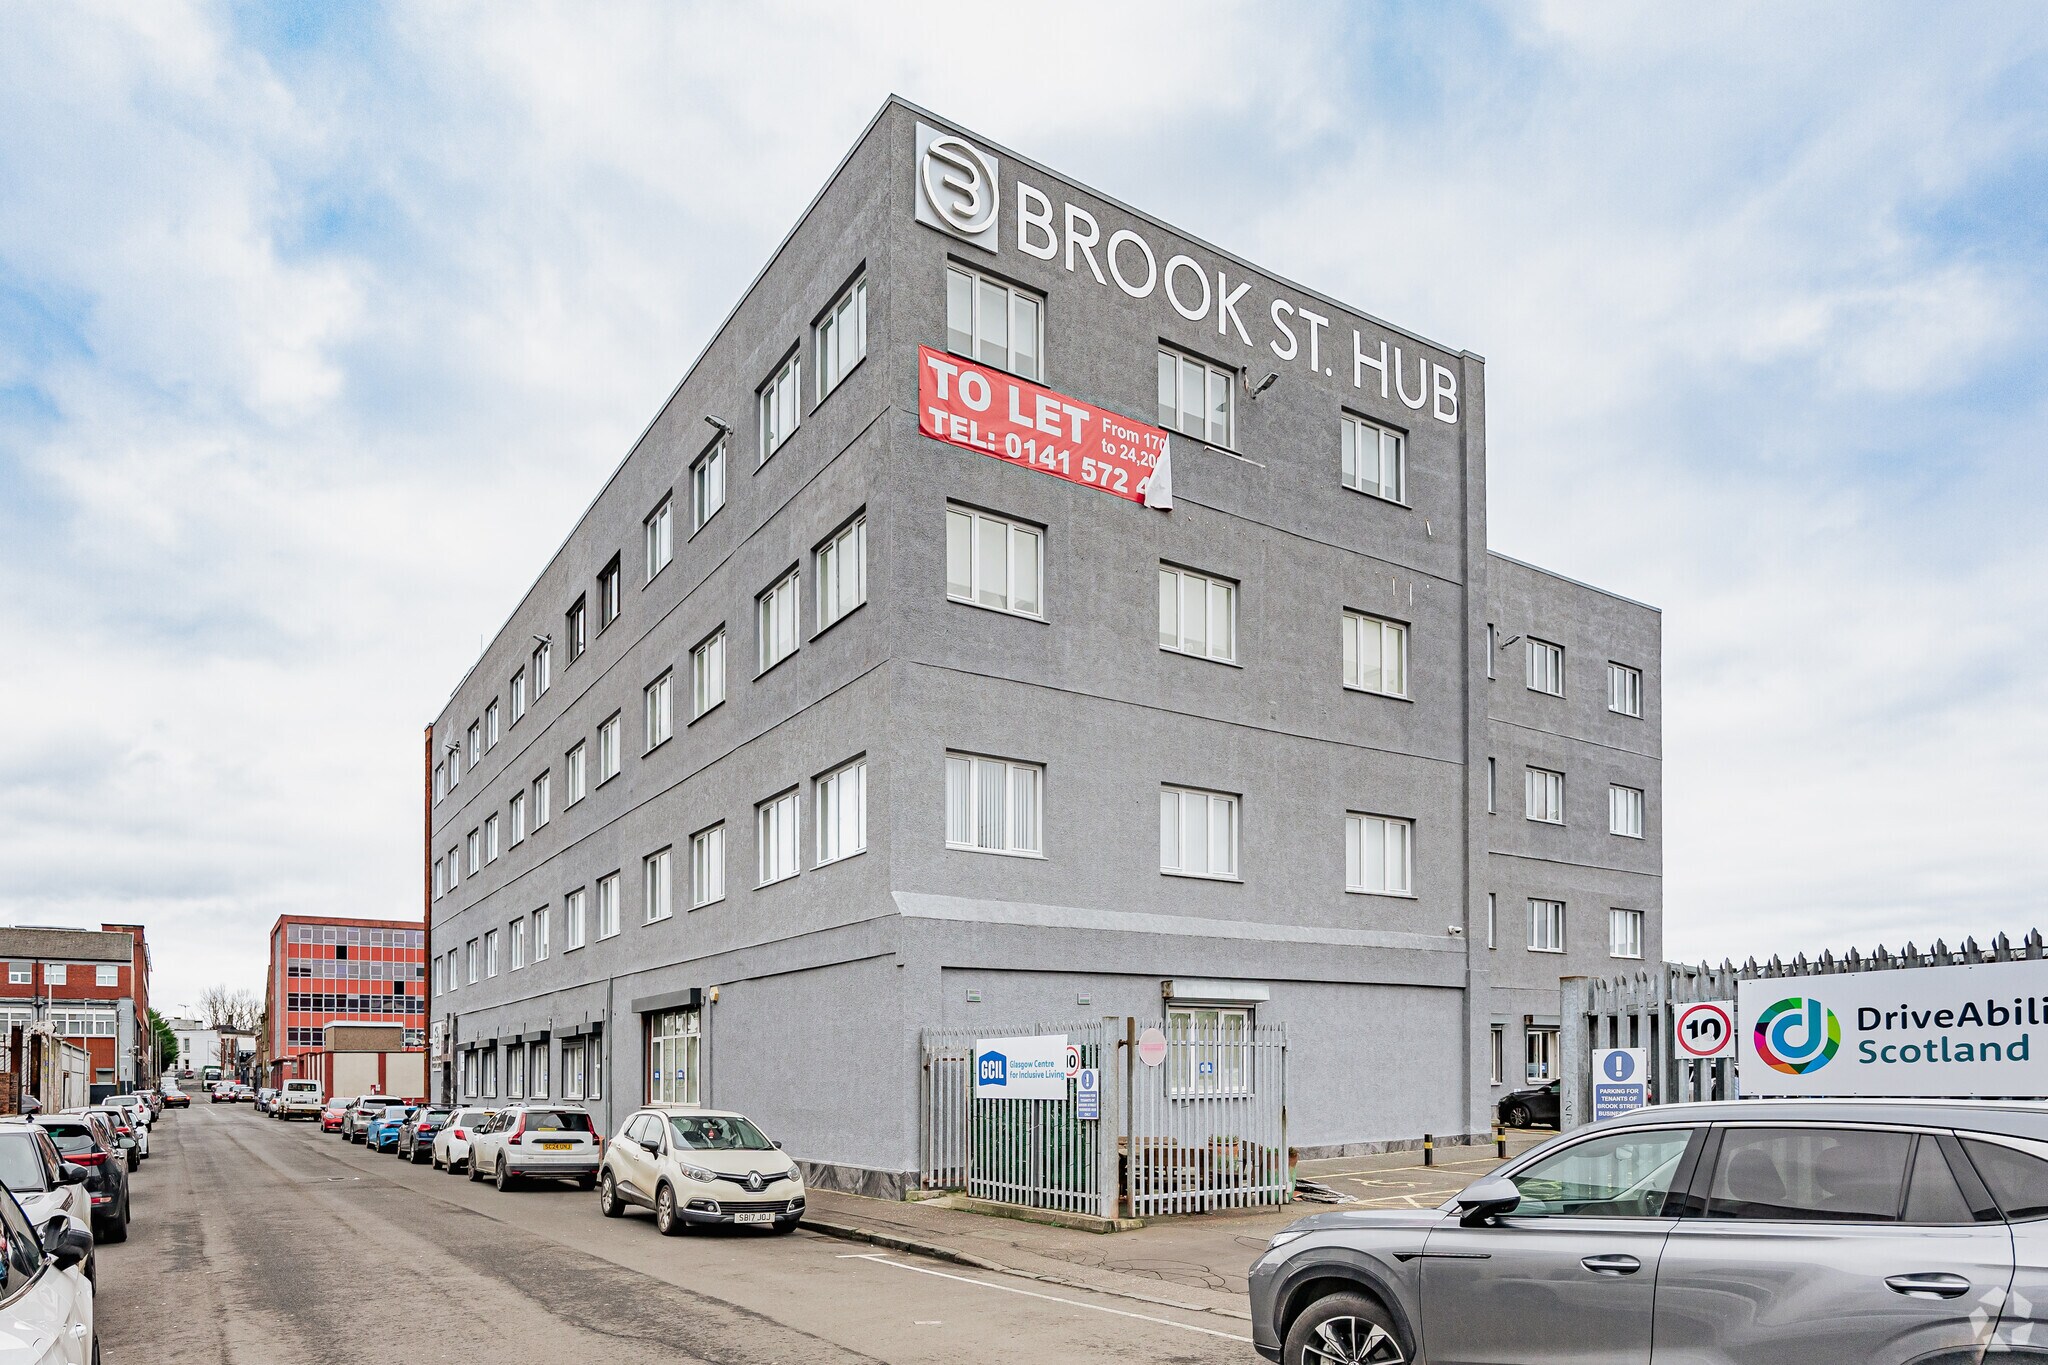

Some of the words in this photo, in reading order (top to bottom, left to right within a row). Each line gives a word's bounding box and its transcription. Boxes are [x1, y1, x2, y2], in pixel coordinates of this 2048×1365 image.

[1017, 181, 1254, 347] BROOK
[1270, 299, 1333, 377] ST.
[1353, 330, 1459, 425] HUB
[927, 356, 992, 412] TO
[1008, 384, 1090, 445] LET
[1102, 417, 1140, 445] From
[928, 406, 996, 452] TEL:
[1005, 432, 1070, 475] 0141
[1081, 456, 1129, 494] 572
[1101, 438, 1116, 455] to
[1857, 996, 2048, 1031] DriveAbili
[1686, 1018, 1721, 1041] 10
[1858, 1033, 2029, 1064] Scotland
[980, 1060, 1005, 1079] GCIL
[1009, 1060, 1033, 1071] Glasgow
[1034, 1059, 1055, 1068] Centre
[1009, 1070, 1018, 1079] for
[1019, 1069, 1044, 1079] Inclusive
[1045, 1070, 1065, 1080] Living
[757, 1213, 771, 1221] JOJ
